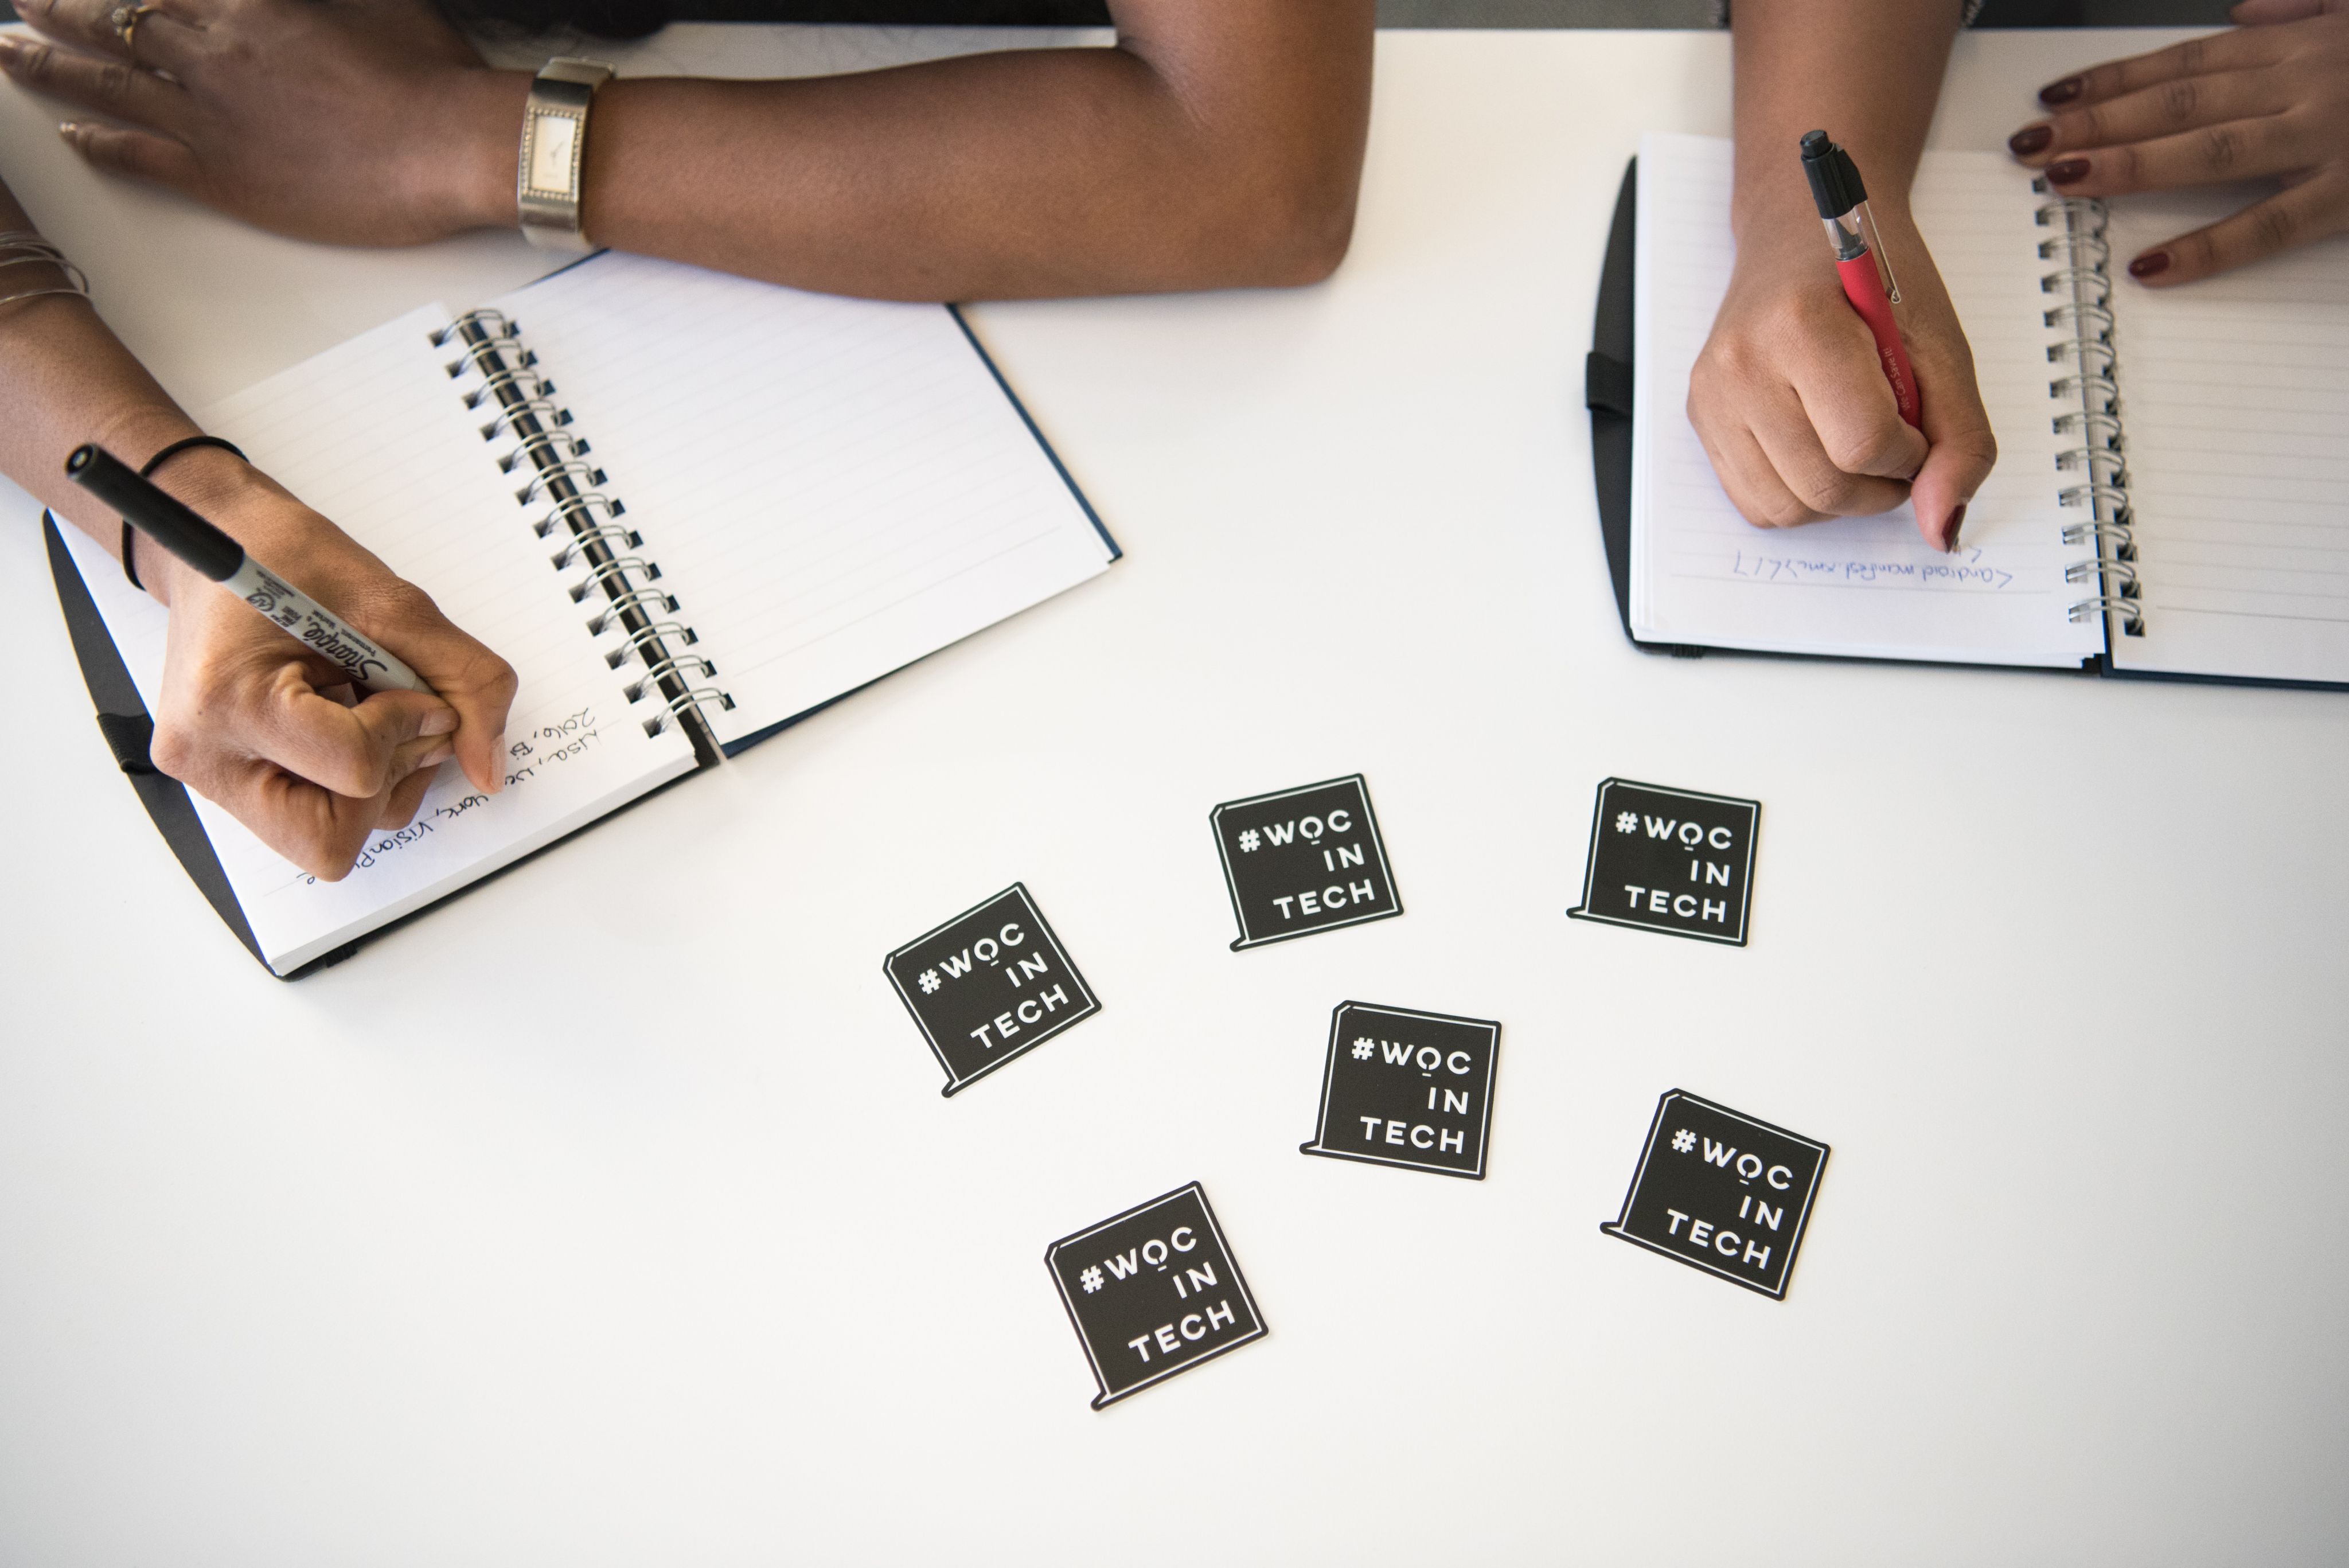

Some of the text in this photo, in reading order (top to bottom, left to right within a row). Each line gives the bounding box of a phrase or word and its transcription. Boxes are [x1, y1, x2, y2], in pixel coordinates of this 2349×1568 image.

[1888, 357, 1900, 379] Save
[1894, 379, 1906, 396] Can
[302, 619, 388, 681] Sharpie
[533, 707, 595, 739] 2016,
[505, 767, 534, 786] Ne
[1238, 809, 1352, 853] #WOC
[1615, 811, 1733, 852] #WOC
[1322, 842, 1365, 872] IN
[1689, 859, 1731, 887] IN
[1272, 878, 1375, 920] TECH
[1624, 884, 1726, 923] TECH
[917, 922, 1025, 995] #WOC
[1005, 951, 1049, 988] IN
[969, 983, 1070, 1049] TECH
[1351, 1036, 1472, 1078] #WOC
[1427, 1086, 1469, 1115] IN
[1359, 1115, 1465, 1154] TECH
[1671, 1128, 1793, 1191] #WOC
[1738, 1195, 1784, 1231] IN
[1667, 1208, 1771, 1270] TECH
[1079, 1226, 1197, 1294] #WOC
[1172, 1261, 1218, 1300] IN
[1127, 1299, 1236, 1363] TECH
